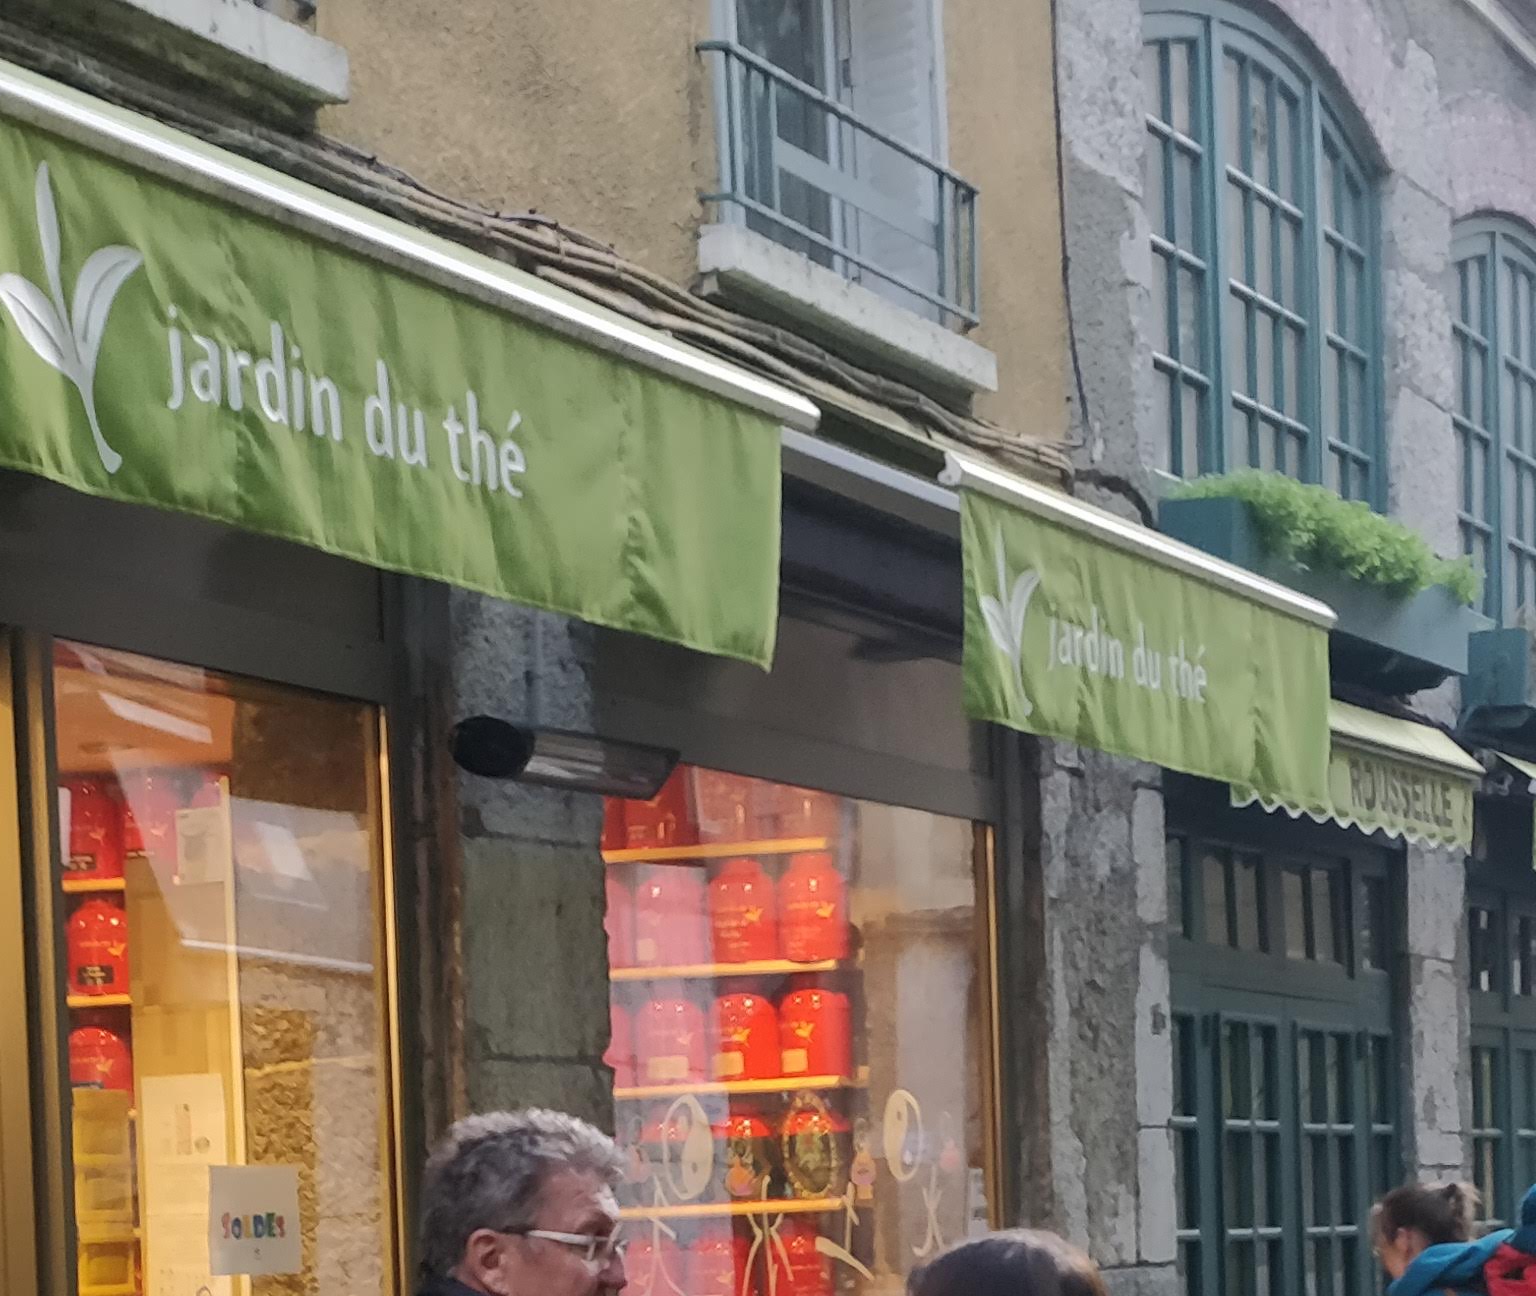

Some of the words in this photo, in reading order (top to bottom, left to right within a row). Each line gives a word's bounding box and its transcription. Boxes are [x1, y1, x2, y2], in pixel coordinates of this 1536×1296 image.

[166, 304, 343, 442] jardin
[363, 361, 427, 468] du
[443, 390, 527, 499] thé
[1047, 602, 1125, 680] jardin
[1132, 620, 1161, 690] du
[1168, 634, 1207, 704] thé
[221, 1211, 286, 1240] SOLDES
